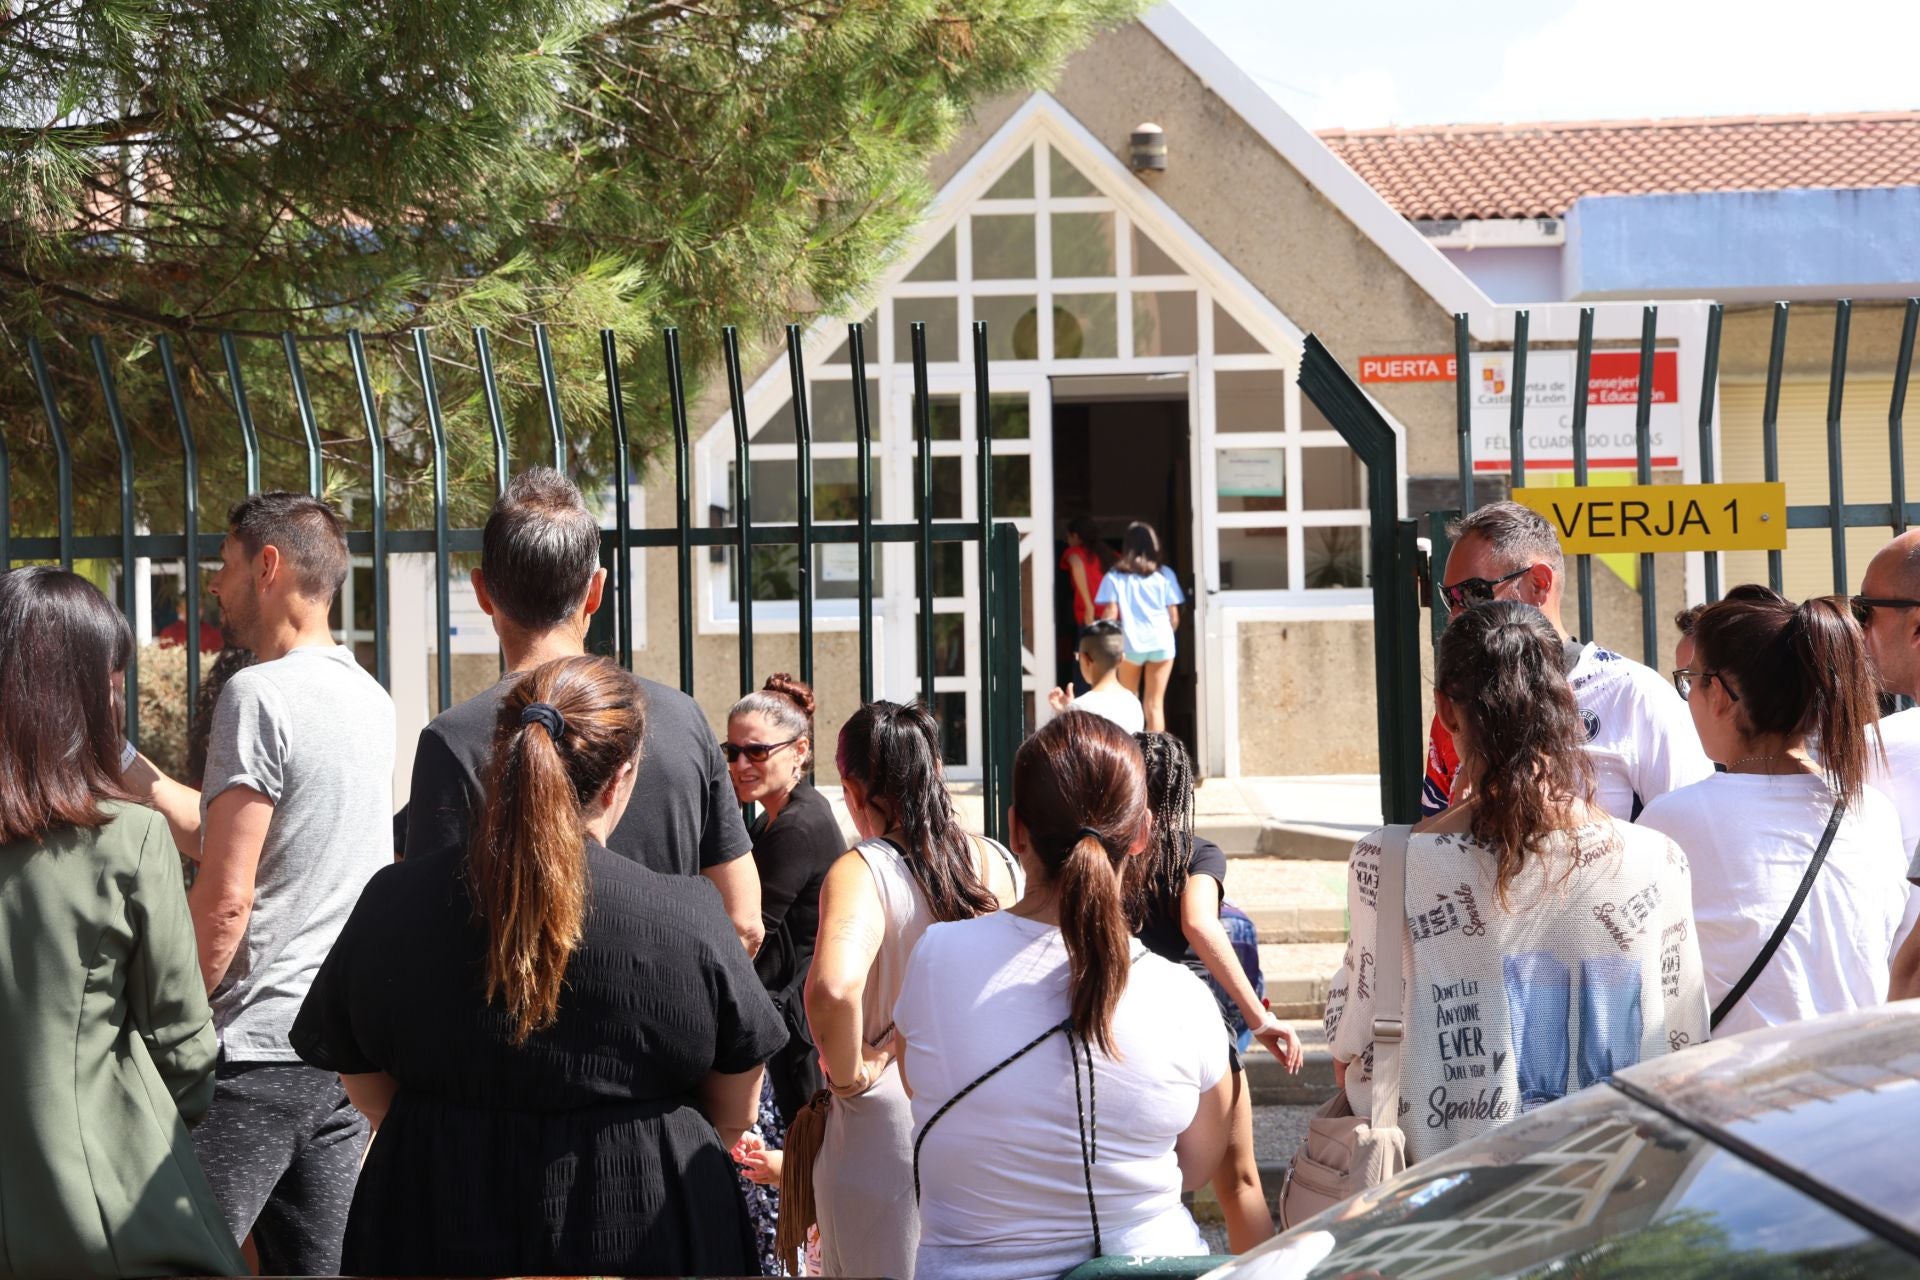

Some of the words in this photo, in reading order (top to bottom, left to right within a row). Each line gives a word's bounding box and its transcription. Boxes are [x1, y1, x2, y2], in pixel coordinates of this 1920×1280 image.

[1363, 359, 1440, 378] PUERTA
[1525, 382, 1547, 391] nta
[1549, 381, 1566, 391] de
[1588, 374, 1641, 391] onsejerí
[1535, 393, 1567, 404] León
[1599, 388, 1666, 404] Educaón
[1529, 434, 1609, 450] CUADDO
[1614, 432, 1664, 447] LOS
[1552, 499, 1711, 538] VERJA
[1723, 498, 1739, 534] 1
[1437, 1003, 1481, 1028] ANYONE
[1438, 1026, 1486, 1061] EVER
[1427, 1085, 1511, 1130] Sparkle
